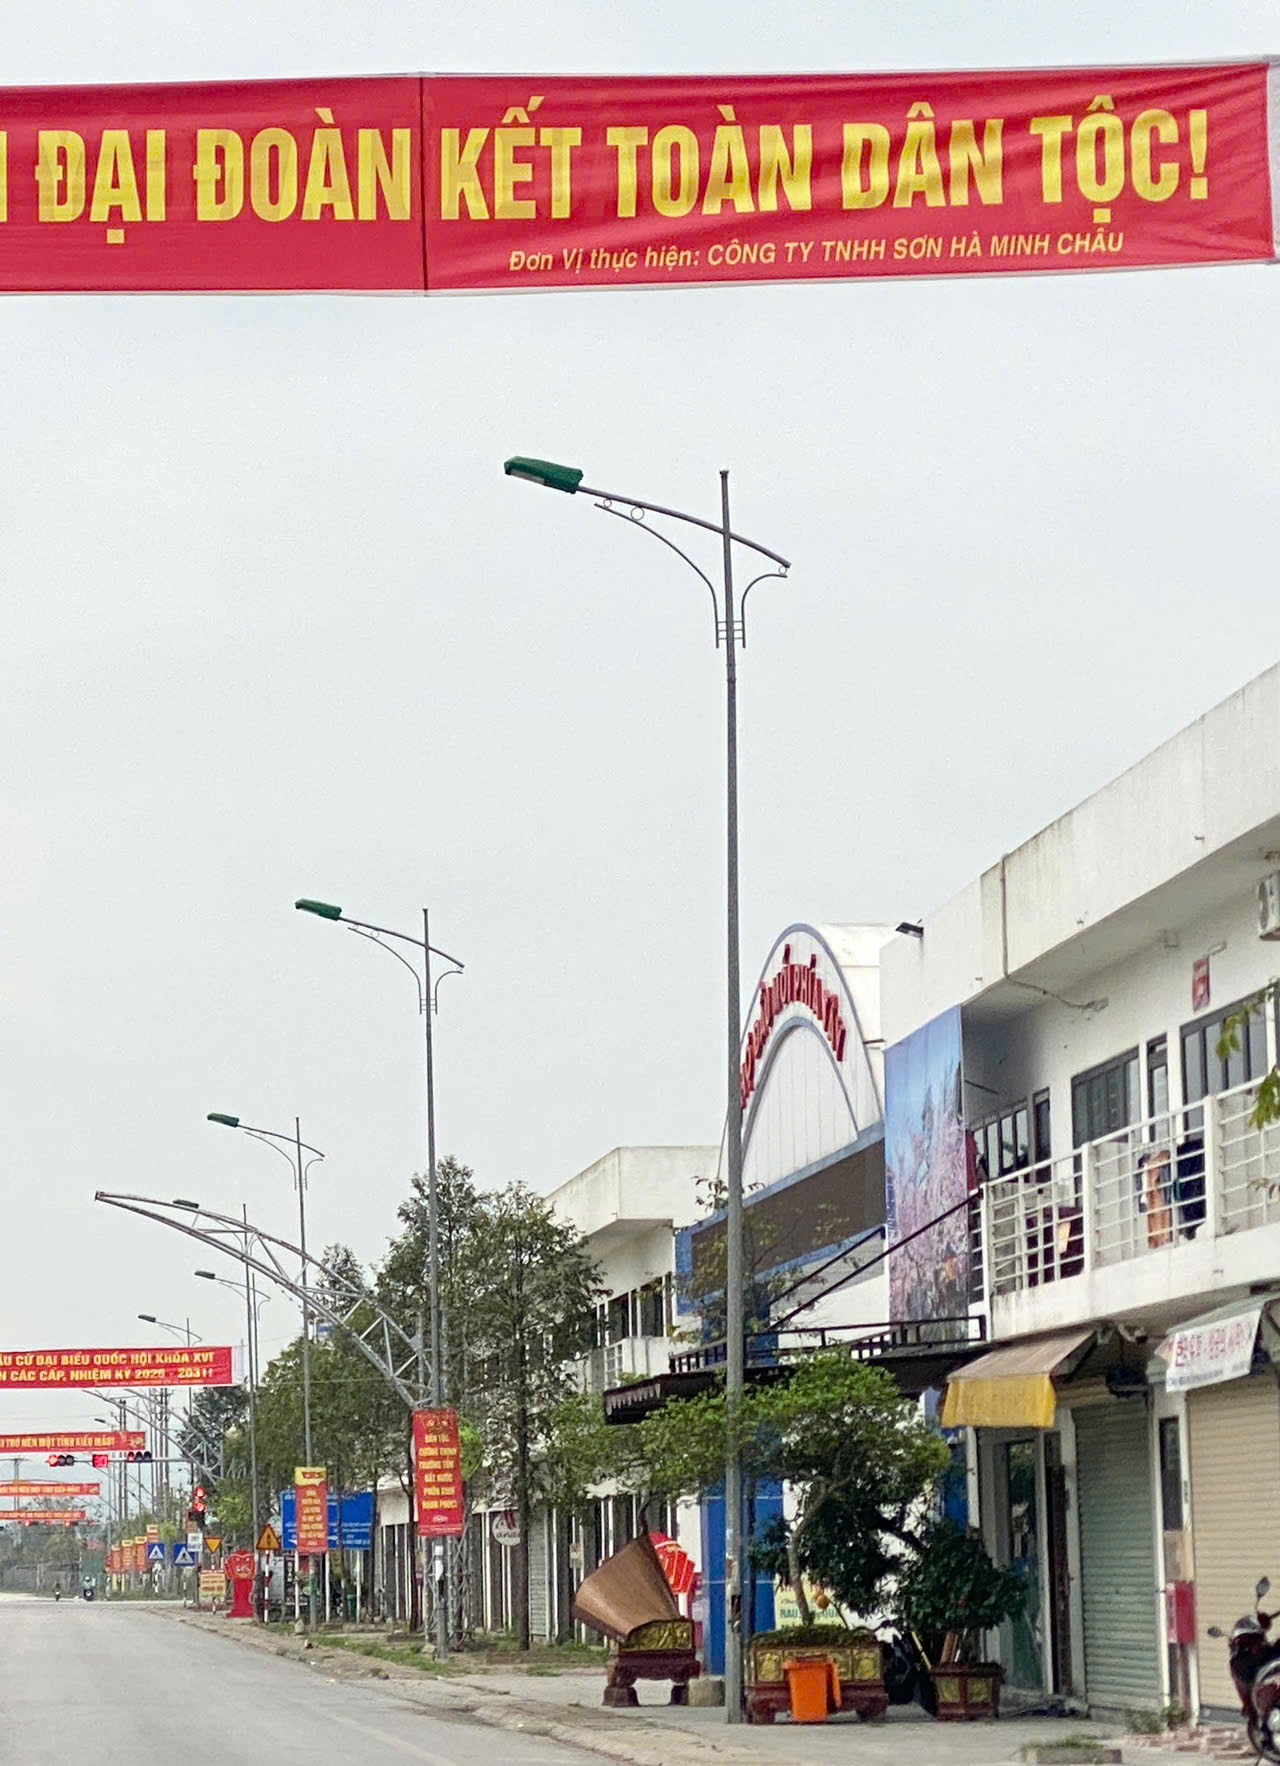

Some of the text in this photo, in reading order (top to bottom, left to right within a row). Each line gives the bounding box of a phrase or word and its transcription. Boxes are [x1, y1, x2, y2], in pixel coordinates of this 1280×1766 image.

[35, 129, 166, 244] ĐẠI
[193, 108, 412, 222] ĐOÀN
[440, 96, 582, 221] KẾT
[608, 106, 814, 219] TOÀN
[841, 102, 1003, 210] DÂN
[1029, 95, 1208, 225] TỘC!
[509, 227, 1124, 274] Đơn Vị thực hiện: CÔNG TY TNHH SƠN HÀ MINH CHÂU
[10, 1367, 36, 1381] CÁC
[131, 1353, 152, 1366] HỘI
